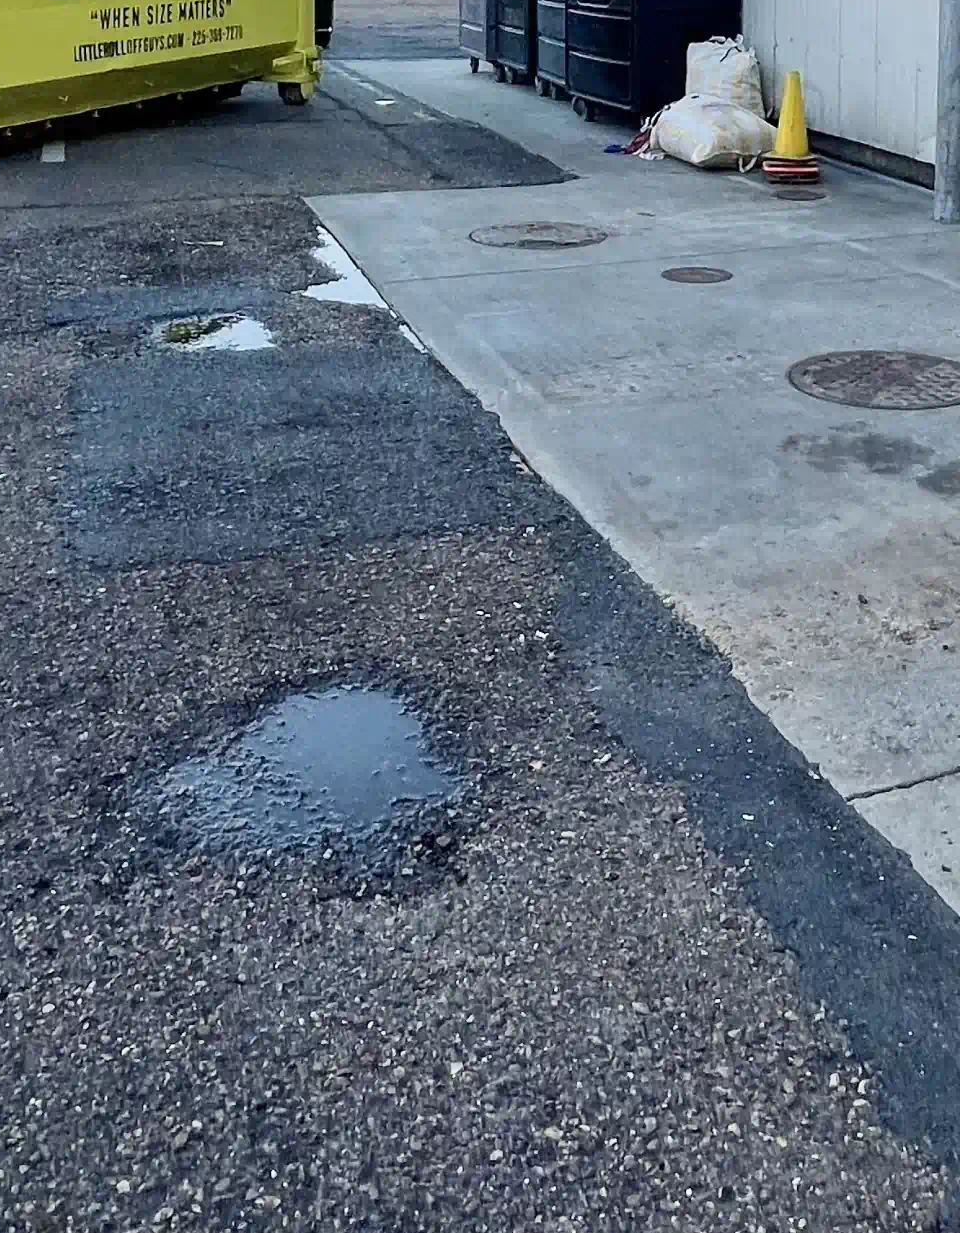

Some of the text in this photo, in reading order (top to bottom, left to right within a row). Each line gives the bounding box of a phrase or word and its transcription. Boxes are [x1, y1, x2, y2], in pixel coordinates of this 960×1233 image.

[90, 8, 140, 30] “WHEN
[147, 3, 173, 25] SIZE
[74, 33, 184, 62] LITTLEROLLOFFGUYS.COM
